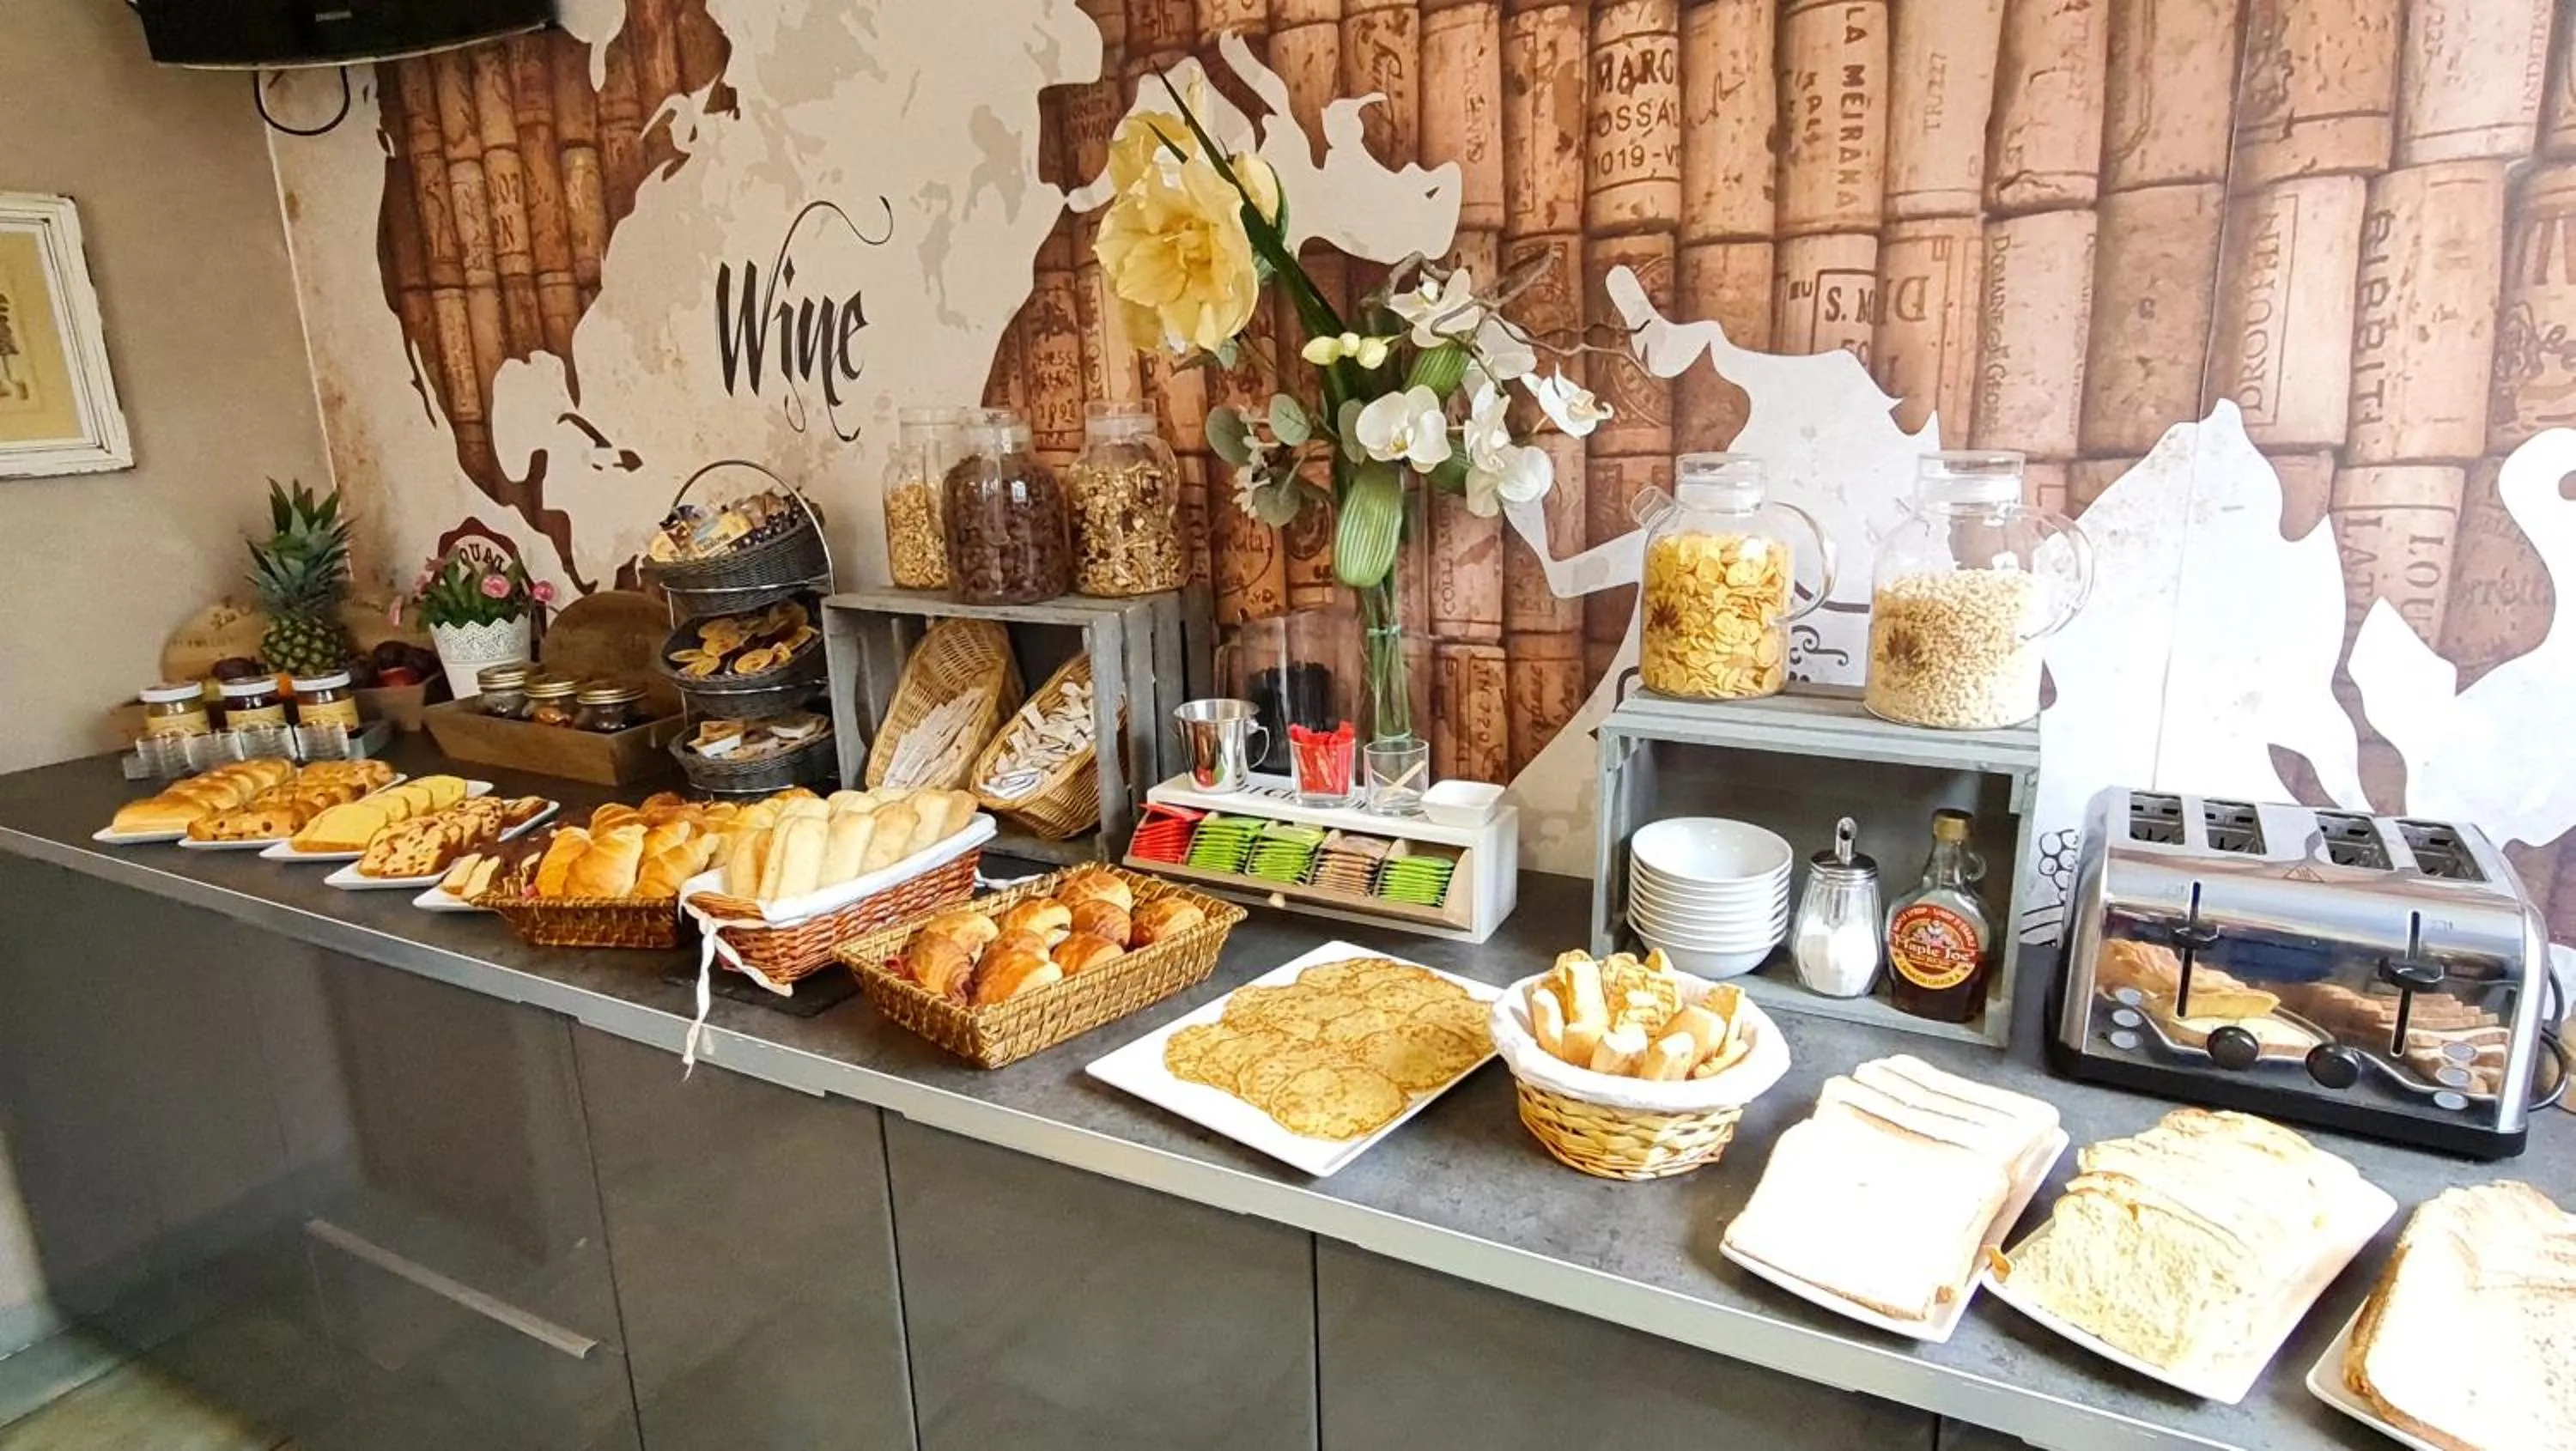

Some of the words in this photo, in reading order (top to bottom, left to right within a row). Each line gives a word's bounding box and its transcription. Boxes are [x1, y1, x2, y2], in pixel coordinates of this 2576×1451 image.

[1844, 7, 1868, 44] LA
[714, 195, 894, 442] Wine
[2238, 213, 2281, 410] DROUHIN
[2401, 534, 2445, 644] LOU
[1944, 948, 1971, 962] Joe
